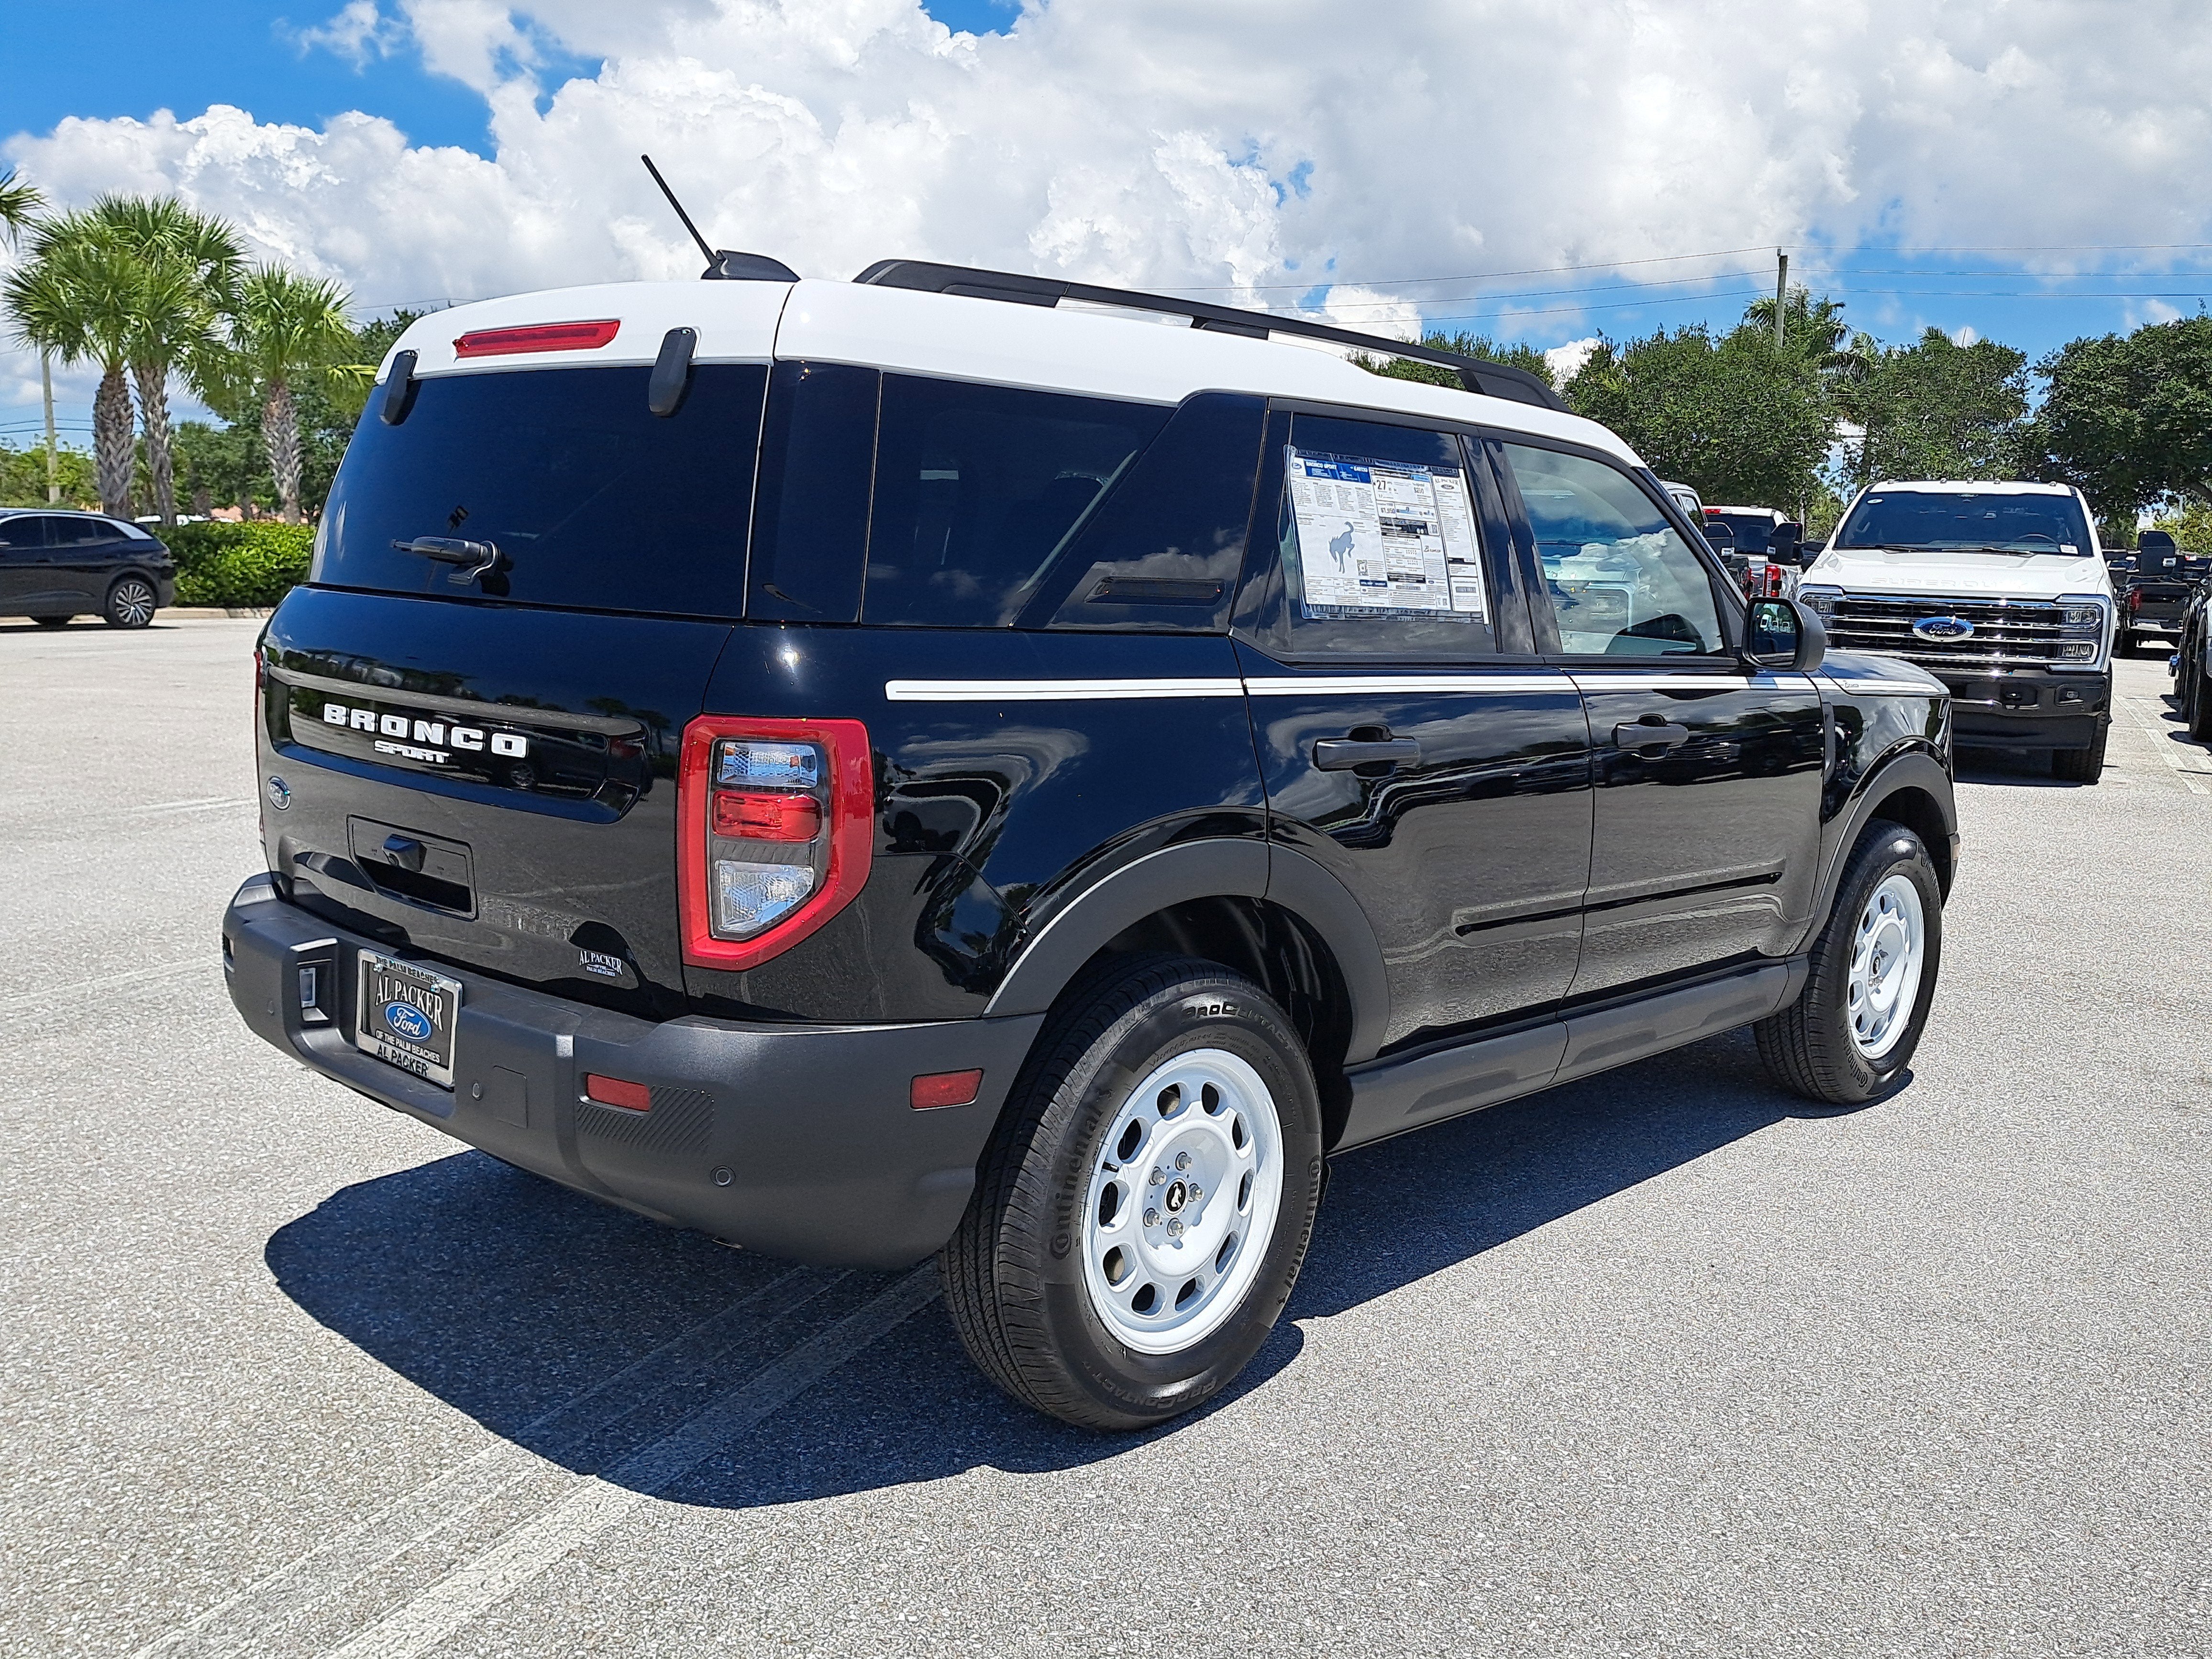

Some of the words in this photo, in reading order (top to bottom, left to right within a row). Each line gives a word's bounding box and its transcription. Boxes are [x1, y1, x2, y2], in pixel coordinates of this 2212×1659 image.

[1376, 479, 1386, 490] 27
[1871, 577, 1957, 587] SUPER
[1929, 623, 1958, 636] Ford
[323, 703, 529, 758] BRONCO
[375, 740, 452, 763] SPORT
[389, 960, 407, 973] PALM
[579, 950, 590, 966] AL
[590, 952, 623, 975] PACKER
[375, 974, 392, 1006] AL
[394, 979, 443, 1031] PACKER
[394, 1007, 422, 1036] Ford
[376, 1031, 384, 1040] OF
[384, 1033, 395, 1044] THE
[396, 1036, 411, 1051] PALM
[411, 1045, 441, 1063] BEACHES
[377, 1044, 389, 1058] AL
[390, 1049, 429, 1076] PACKER
